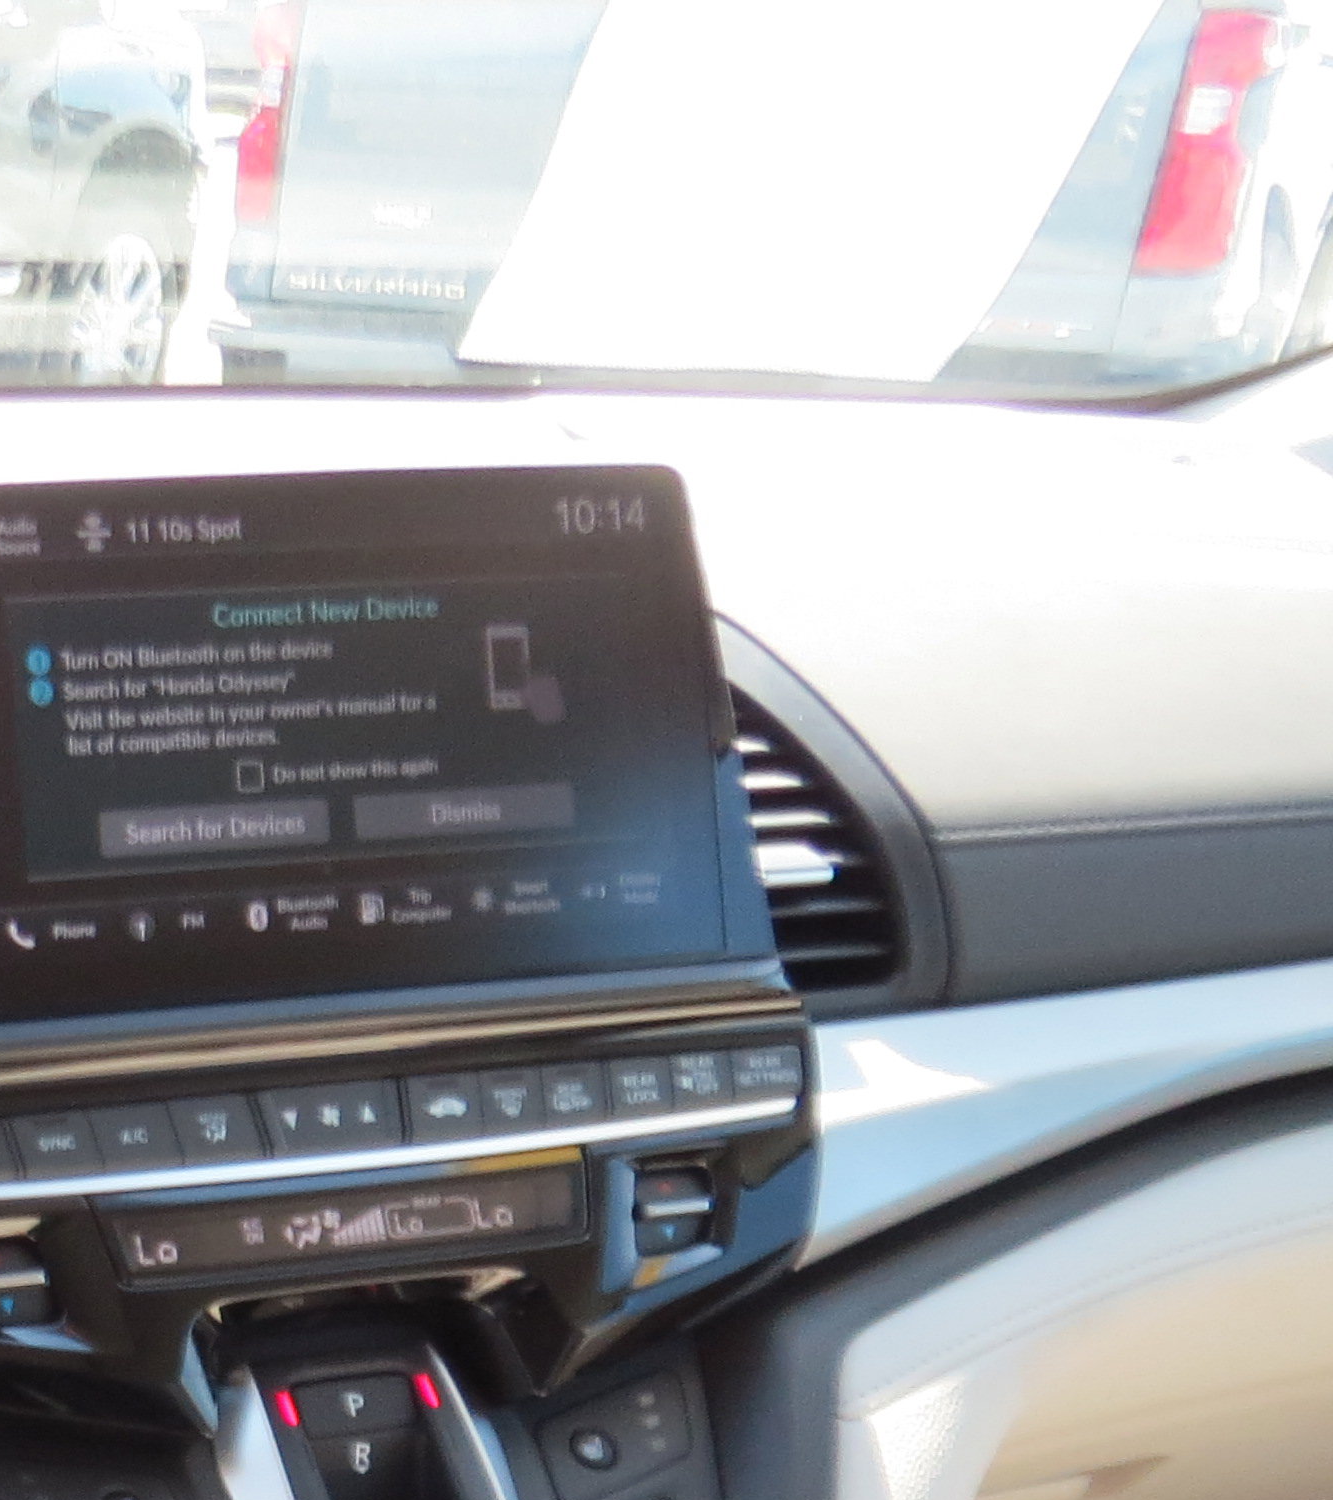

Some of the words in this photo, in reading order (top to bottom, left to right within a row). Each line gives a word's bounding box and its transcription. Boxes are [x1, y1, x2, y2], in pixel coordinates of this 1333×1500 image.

[195, 514, 241, 545] Spot
[556, 497, 646, 535] 10:14
[212, 601, 303, 628] Connect
[310, 599, 359, 624] New
[367, 597, 439, 621] Device
[62, 650, 99, 672] Turn
[102, 647, 133, 669] ON
[136, 643, 220, 669] Bluetooth
[249, 643, 276, 662] the
[63, 678, 119, 702] Search
[124, 675, 147, 698] for
[66, 705, 103, 731] Visit
[108, 705, 136, 727] the
[139, 702, 205, 726] website
[209, 701, 225, 723] in
[229, 704, 266, 725] your
[338, 692, 396, 716] manual
[400, 692, 423, 713] for
[68, 733, 93, 756] list
[97, 732, 114, 754] of
[119, 728, 209, 755] compatible
[126, 820, 193, 846] Search
[197, 817, 223, 842] for
[230, 811, 306, 839] Devices
[344, 1392, 365, 1418] P
